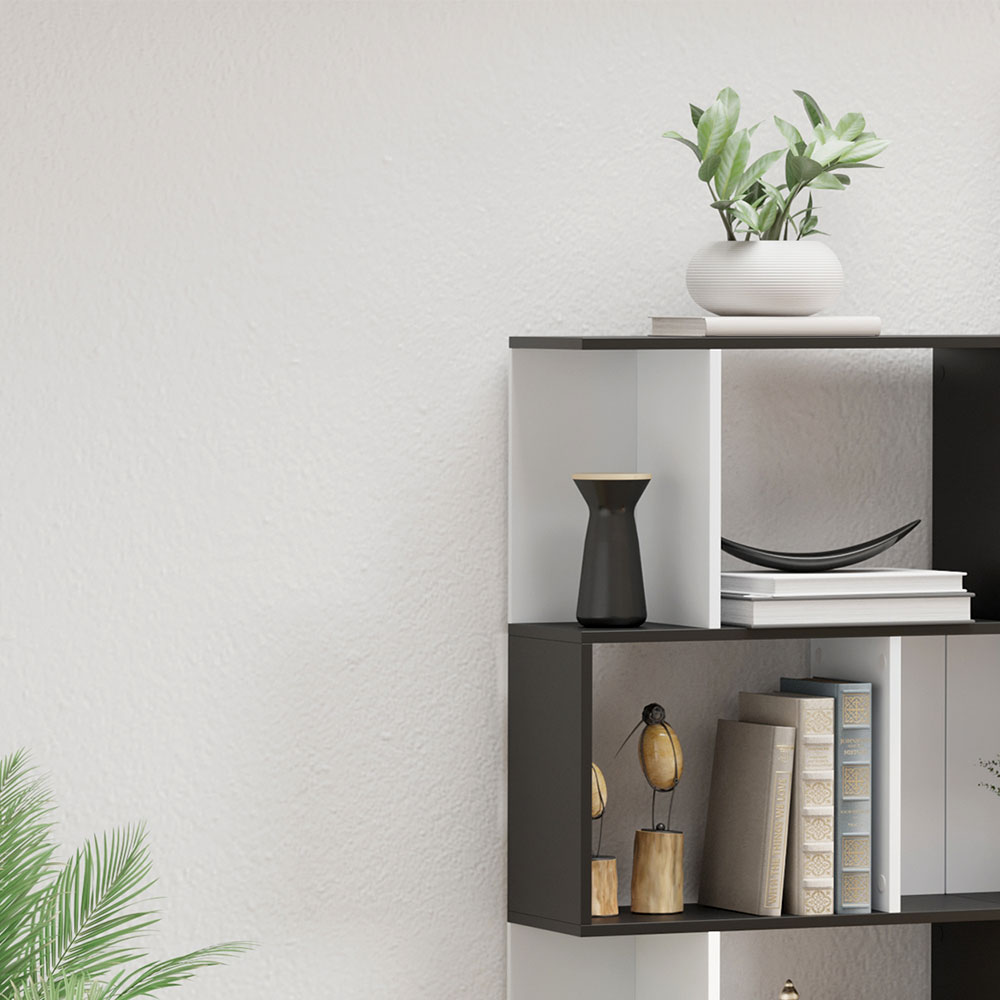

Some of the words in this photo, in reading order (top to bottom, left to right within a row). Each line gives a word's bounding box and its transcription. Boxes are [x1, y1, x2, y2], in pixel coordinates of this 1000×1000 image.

[776, 776, 787, 802] LOVE
[775, 804, 785, 818] WE
[771, 821, 783, 857] THINGS
[770, 858, 780, 875] THE
